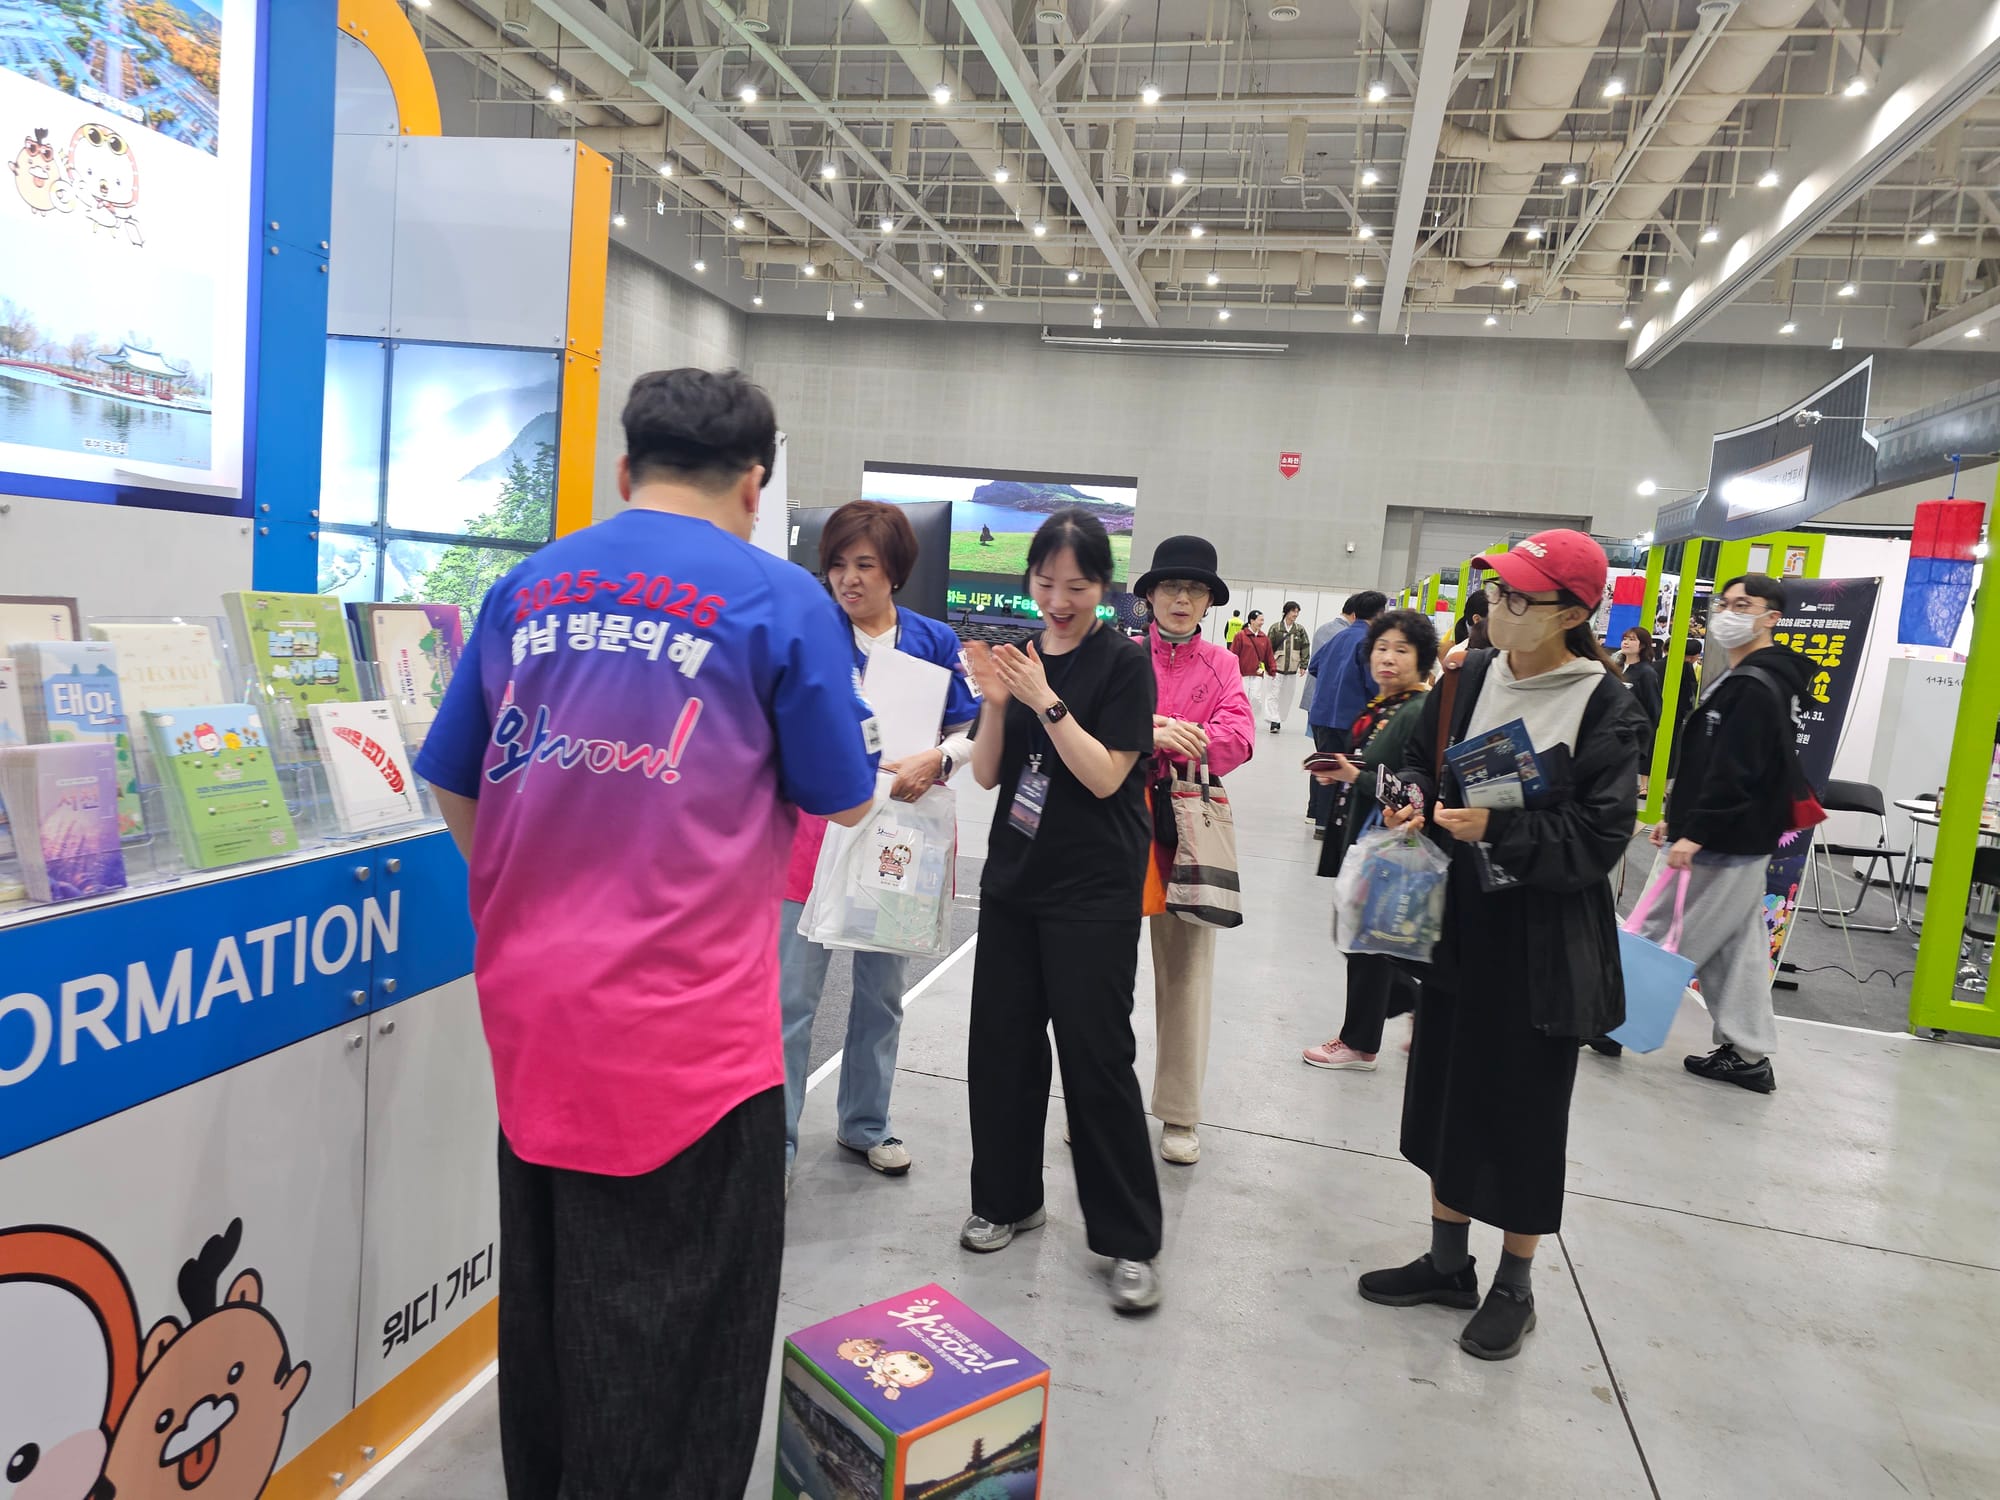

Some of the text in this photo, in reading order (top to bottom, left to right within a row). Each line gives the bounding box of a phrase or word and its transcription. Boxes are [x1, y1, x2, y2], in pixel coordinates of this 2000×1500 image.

[1281, 457, 1299, 465] 소화전
[514, 569, 727, 629] 2025~2026
[969, 592, 992, 606] 시간
[994, 593, 1039, 611] K-Fes
[1095, 604, 1115, 617] po
[512, 611, 714, 679] 충남 방문의 해
[52, 682, 118, 726] 태안
[1811, 711, 1825, 722] 31.
[382, 1242, 494, 1359] 워디 가디
